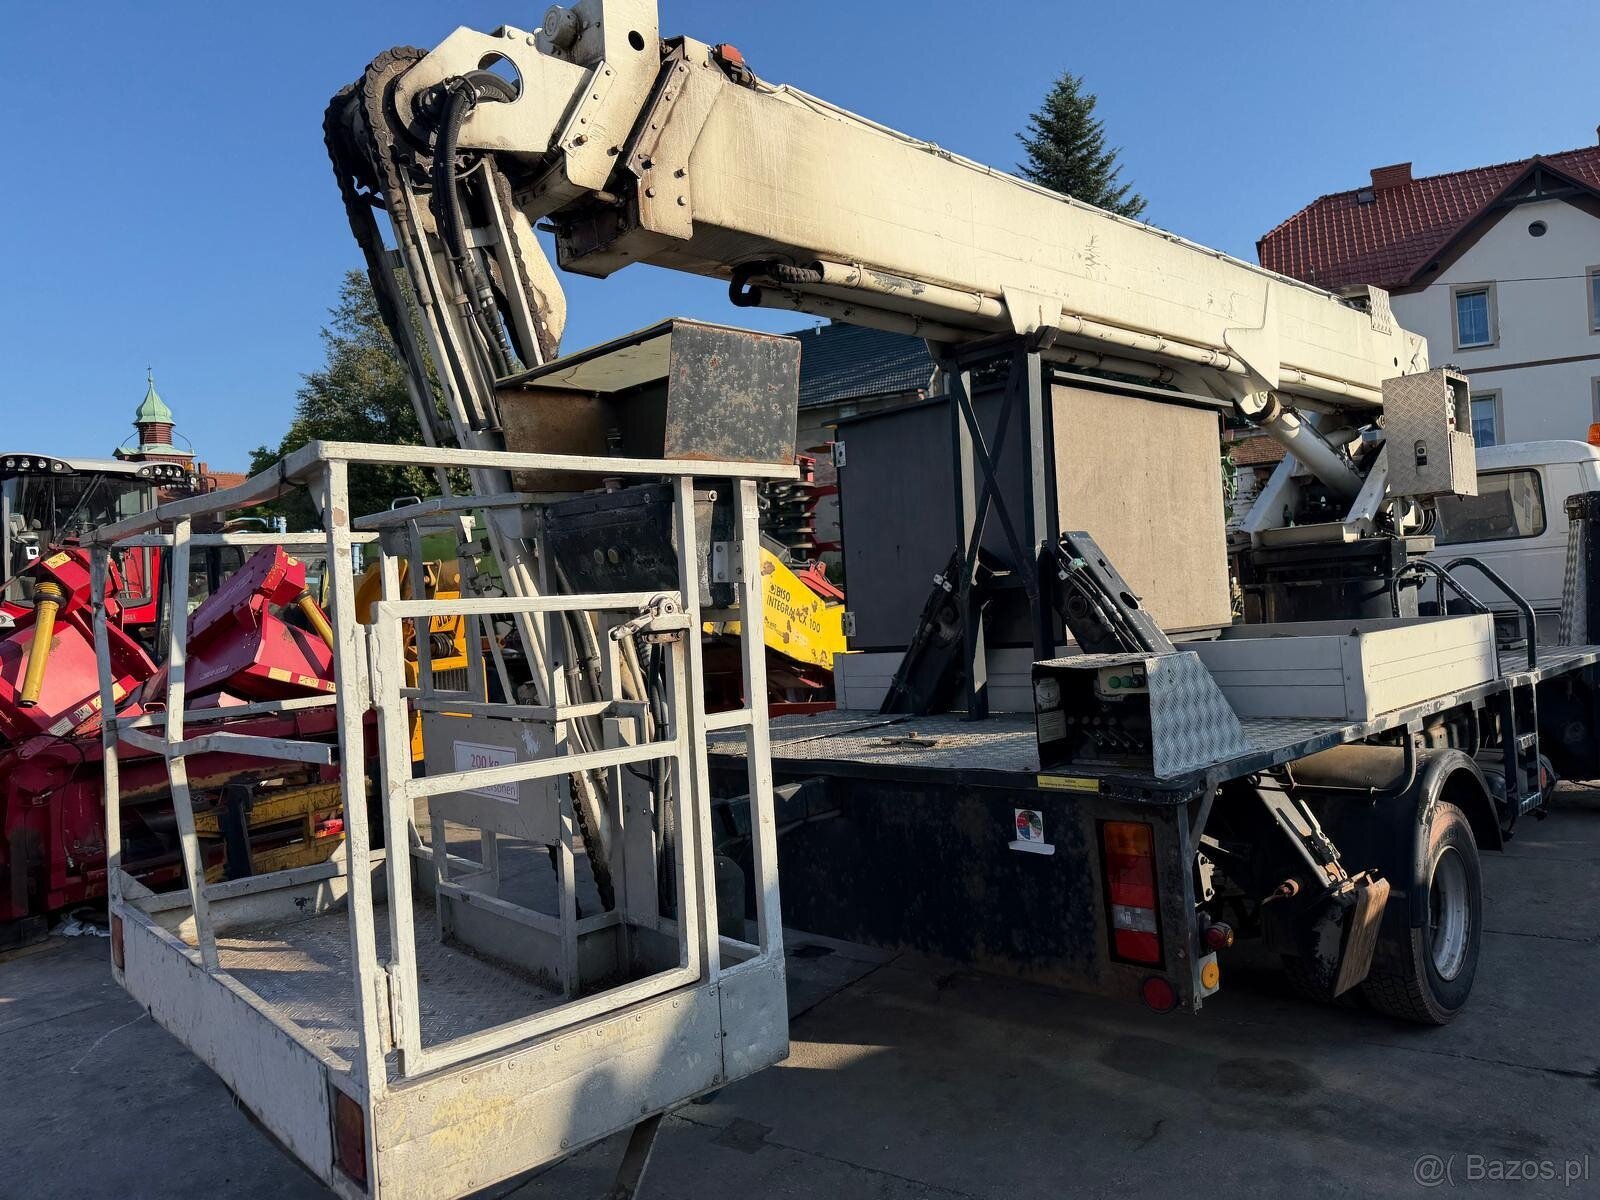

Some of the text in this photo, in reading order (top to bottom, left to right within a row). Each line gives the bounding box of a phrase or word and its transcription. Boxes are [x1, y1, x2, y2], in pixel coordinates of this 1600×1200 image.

[776, 586, 791, 602] BISO
[767, 595, 796, 619] INTEGRA
[470, 753, 487, 768] 200
[483, 784, 516, 797] ersonen
